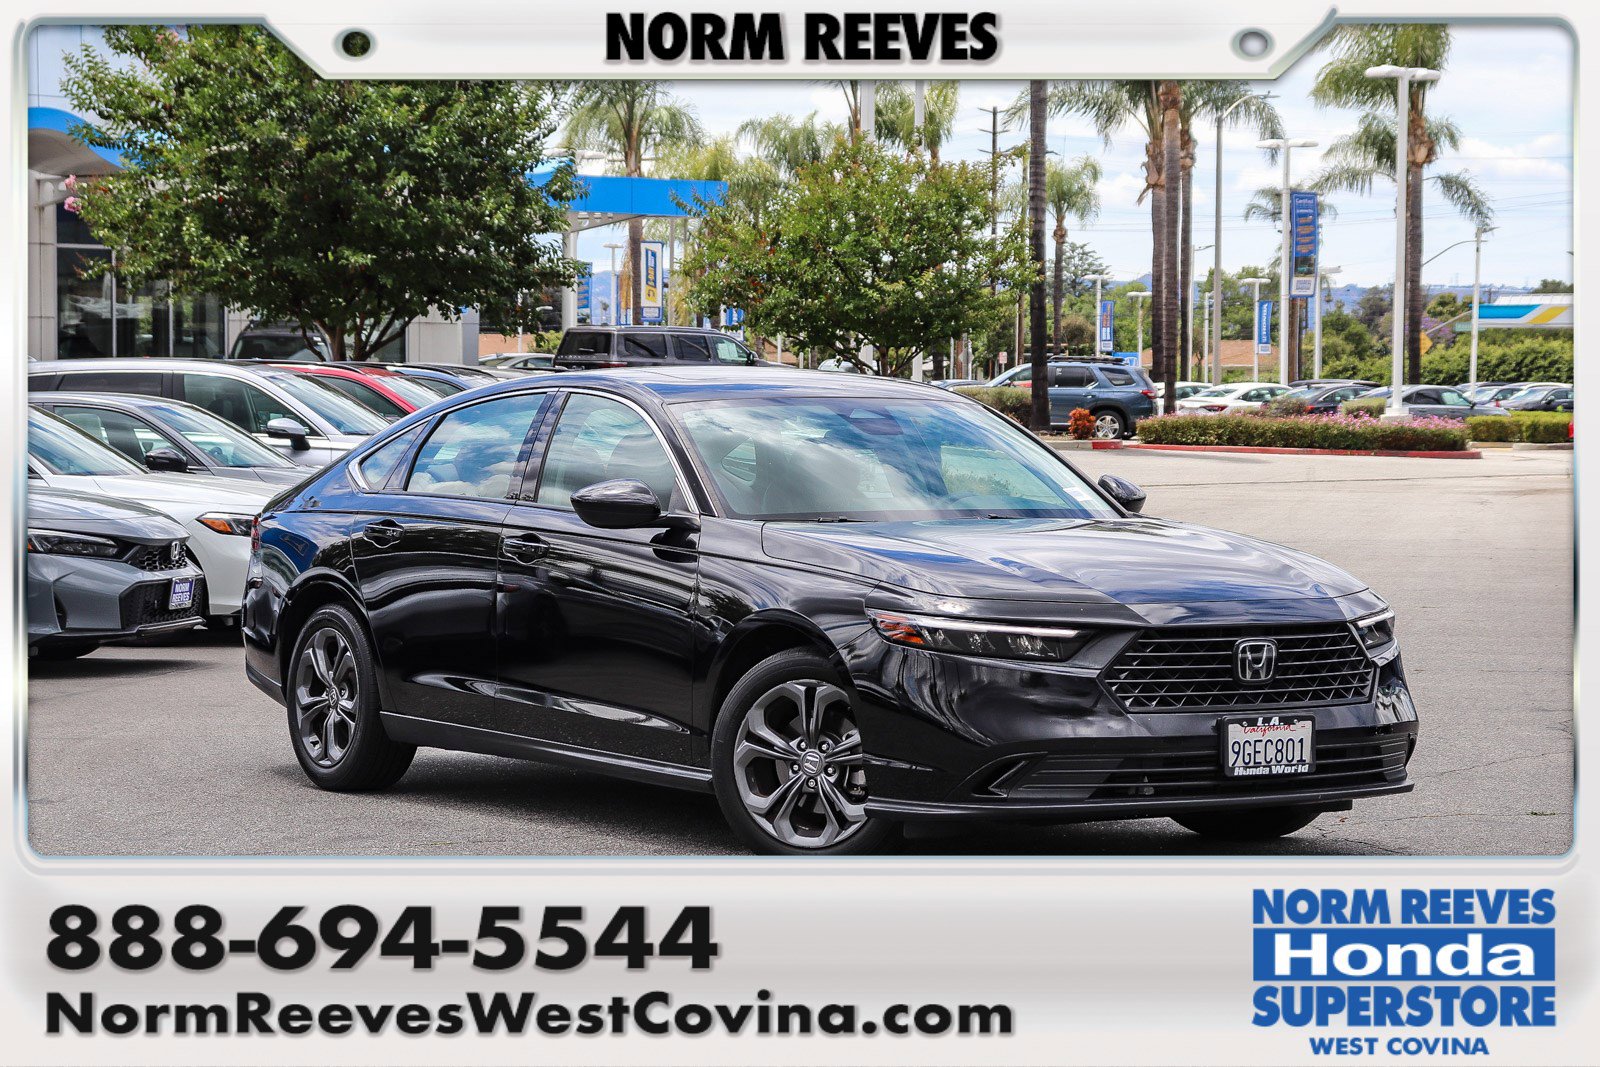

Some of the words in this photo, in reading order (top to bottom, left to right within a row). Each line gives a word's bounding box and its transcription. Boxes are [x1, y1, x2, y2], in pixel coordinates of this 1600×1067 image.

[174, 582, 190, 593] NORM
[171, 592, 190, 602] REEVES
[1256, 716, 1284, 726] L.A.
[1231, 737, 1307, 766] 9GEC801
[1271, 764, 1309, 774] World
